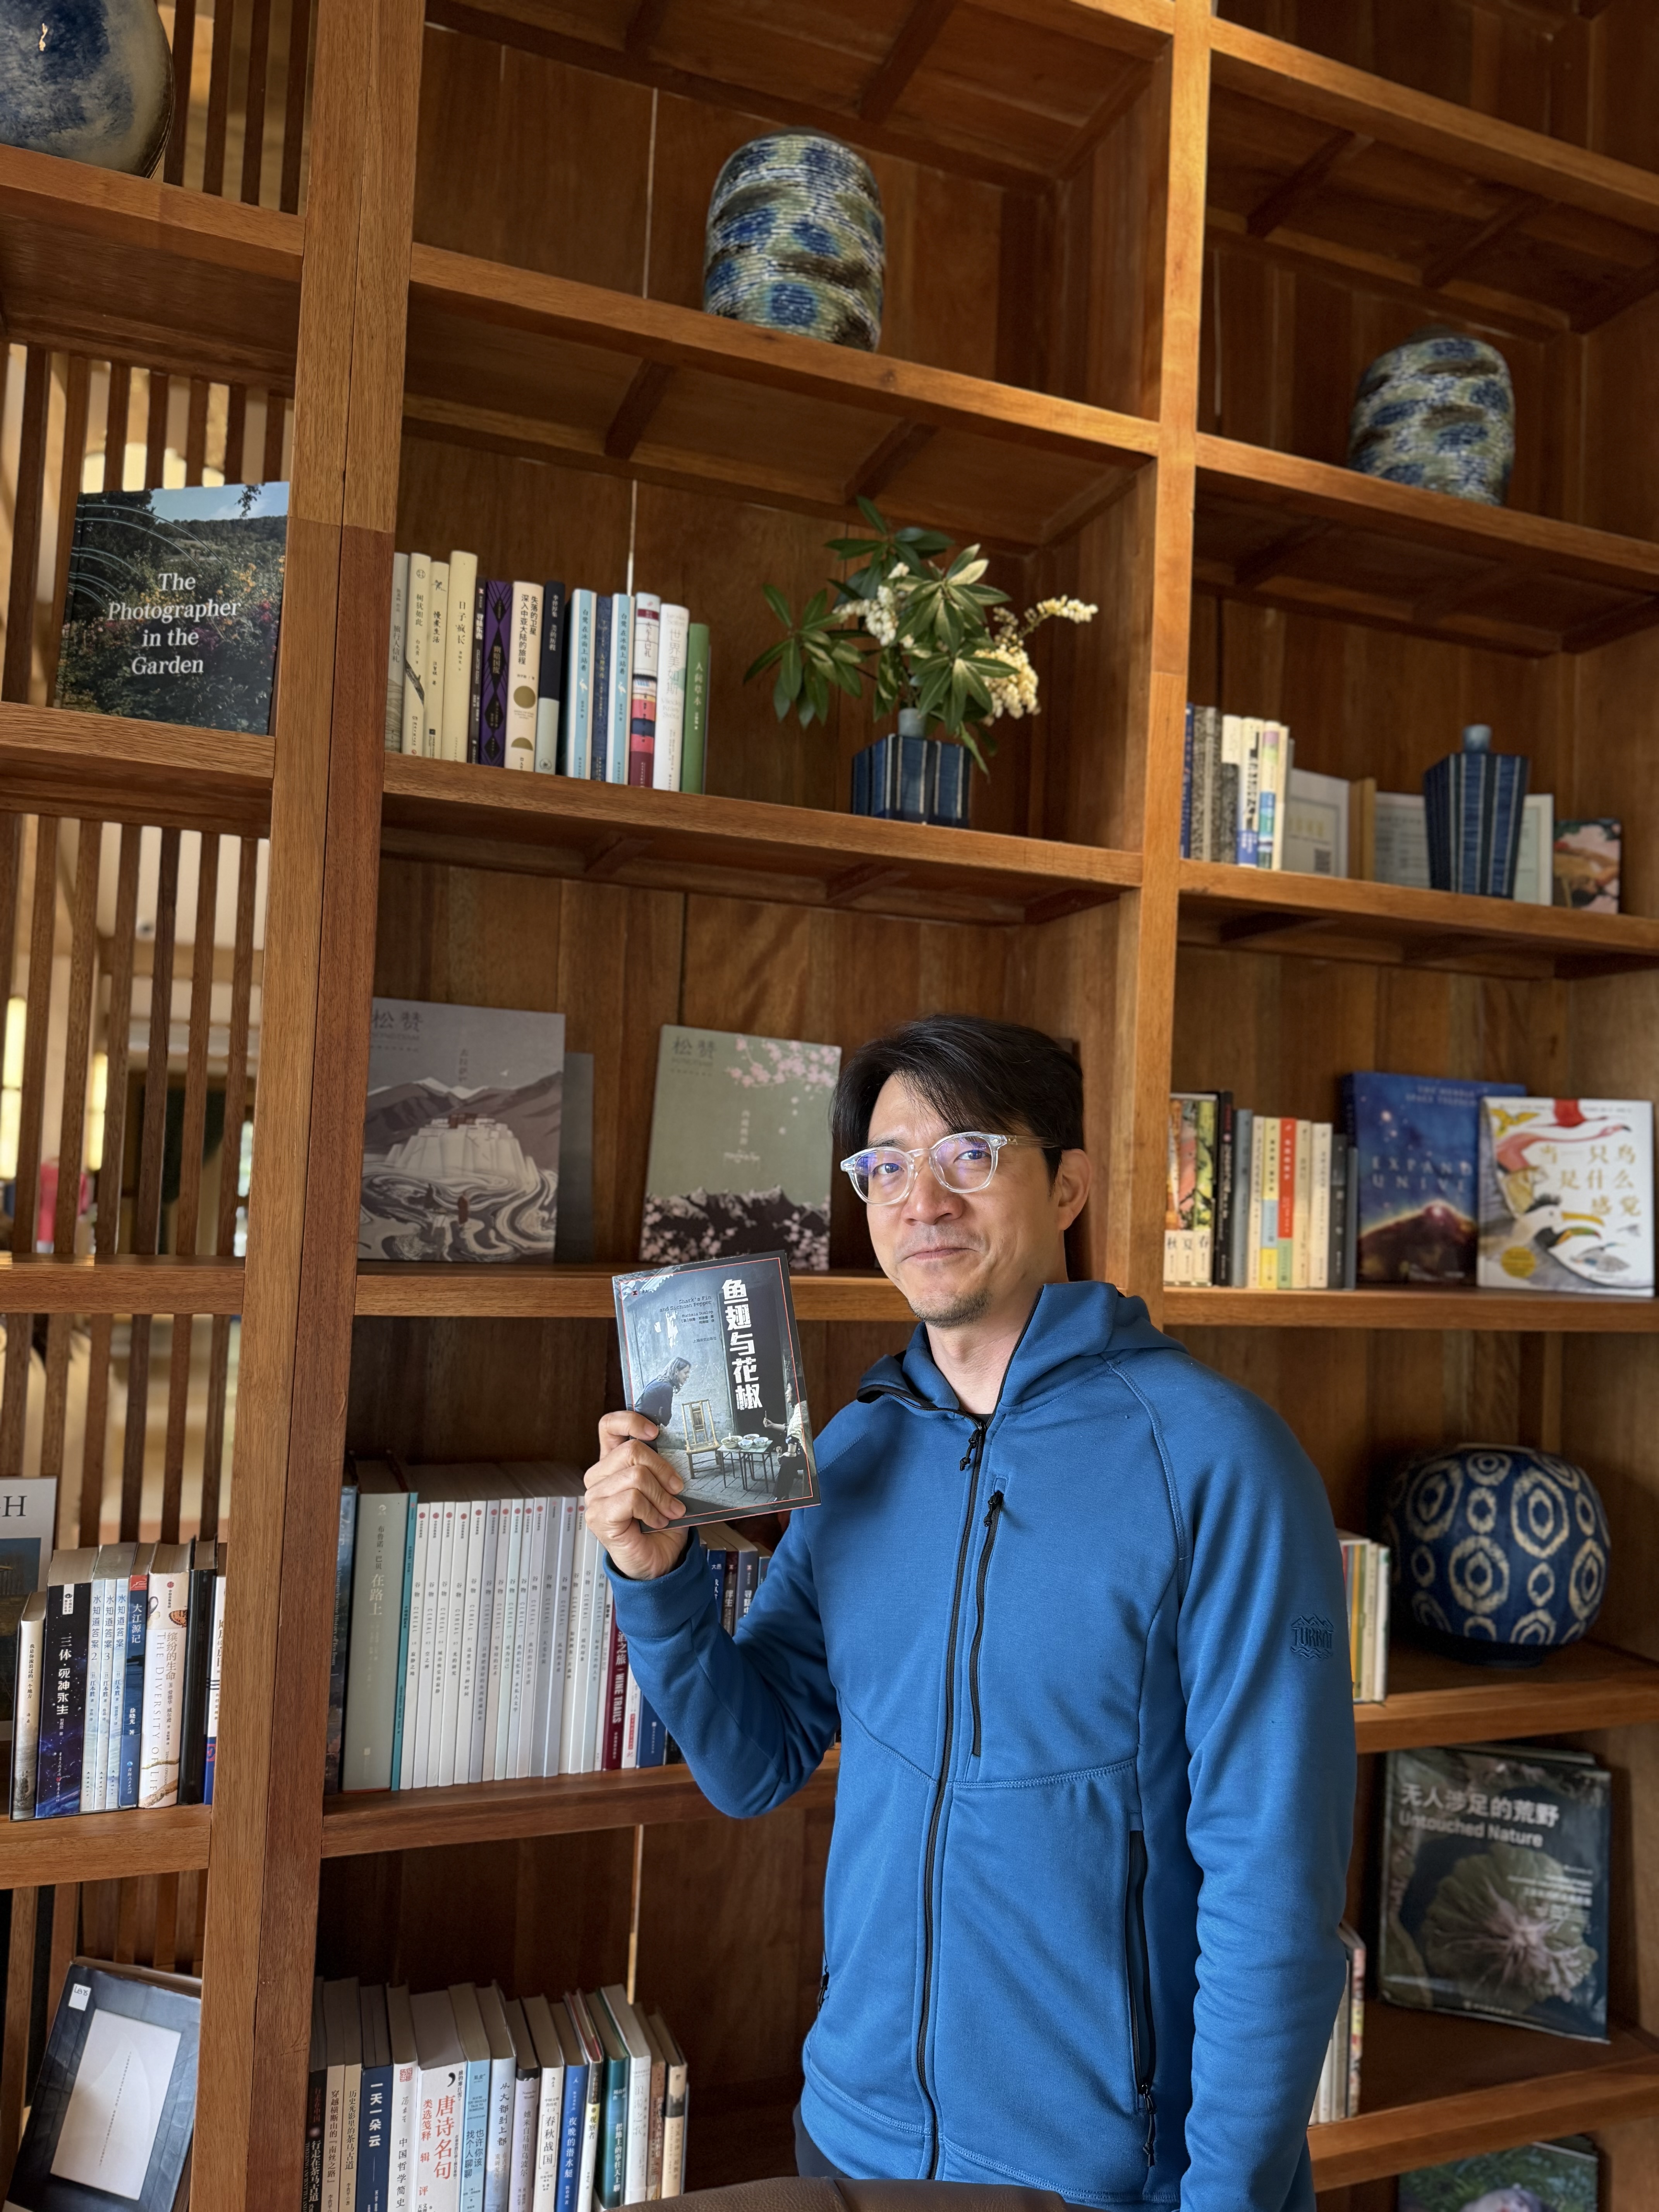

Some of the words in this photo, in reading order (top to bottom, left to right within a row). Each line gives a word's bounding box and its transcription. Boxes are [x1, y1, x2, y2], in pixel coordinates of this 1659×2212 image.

[158, 573, 196, 591] The
[107, 600, 241, 624] Photographer
[415, 593, 424, 627] 树犹如此
[455, 601, 466, 644] 日子疯长
[529, 596, 538, 636] 失落的卫星
[142, 629, 161, 647] in
[168, 628, 199, 646] the
[432, 611, 441, 643] 慢煮生活
[518, 594, 529, 665] 深入中亚大陆的旅程
[392, 625, 401, 663] 旅行人信札
[131, 656, 203, 675] Garden
[666, 628, 681, 695] 世界美如斯
[694, 661, 703, 706] 人间草木
[1540, 1143, 1635, 1164] 当一只鸟
[1560, 1169, 1634, 1190] 是什么
[1591, 1195, 1642, 1217] 感觉
[721, 1279, 763, 1411] 鱼翅与花椒
[0, 1495, 27, 1517] H
[376, 1525, 385, 1570] 布鲁诺·巴贝
[414, 1582, 421, 1597] 谷物
[428, 1582, 435, 1597] 谷物
[441, 1581, 448, 1597] 谷物
[456, 1582, 462, 1598] 谷物
[471, 1578, 477, 1593] 谷物
[486, 1580, 492, 1595] 谷物
[498, 1579, 503, 1594] 谷物
[509, 1578, 515, 1593] 谷物
[520, 1578, 527, 1593] 谷物
[532, 1576, 538, 1591] 谷物
[546, 1574, 552, 1589] 谷物
[562, 1577, 568, 1592] 谷物
[573, 1573, 579, 1588] 谷物
[585, 1570, 591, 1585] 谷物
[599, 1573, 605, 1588] 谷物
[369, 1573, 385, 1616] 在路上
[725, 1590, 733, 1607] 伴生
[744, 1590, 752, 1617] 寻路中
[116, 1594, 126, 1648] 水知道答案
[132, 1603, 143, 1644] 大江源记
[156, 1632, 166, 1658] THE
[165, 1632, 178, 1681] 缤纷的生命
[57, 1636, 72, 1715] 三体·死神永生
[513, 1644, 522, 1712] 我的记忆是一本私人文学
[614, 1673, 625, 1695] WINE
[152, 1667, 165, 1739] DIVERSITY
[612, 1697, 623, 1723] TRAILS
[151, 1747, 159, 1764] OF
[149, 1771, 159, 1798] LIFE
[1401, 1783, 1559, 1828] 无人涉足的荒野
[1399, 1810, 1485, 1839] Untouched
[1487, 1824, 1543, 1848] Nature
[369, 2083, 383, 2147] 一天一朵云
[421, 2099, 433, 2142] 类选笺释
[497, 2082, 510, 2146] 从大都到上都
[588, 2116, 597, 2140] 观察者
[327, 2090, 340, 2183] 穿越横断山的『南丝之路』
[345, 2090, 356, 2170] 历史光影里的茶马古道
[433, 2095, 456, 2180] 唐诗名句
[520, 2110, 531, 2177] 她来自马里乌波尔
[542, 2116, 555, 2165] 春秋战国
[420, 2152, 430, 2163] 辑
[464, 2130, 475, 2179] 找个人聊聊
[474, 2128, 484, 2167] 也许你该
[564, 2117, 577, 2178] 夜晚的潜水艇
[613, 2123, 623, 2193] 把地上的事往天上聊
[309, 2140, 321, 2202] 行走在茶马古道
[396, 2137, 408, 2209] 中国哲学简史
[419, 2185, 429, 2197] 评
